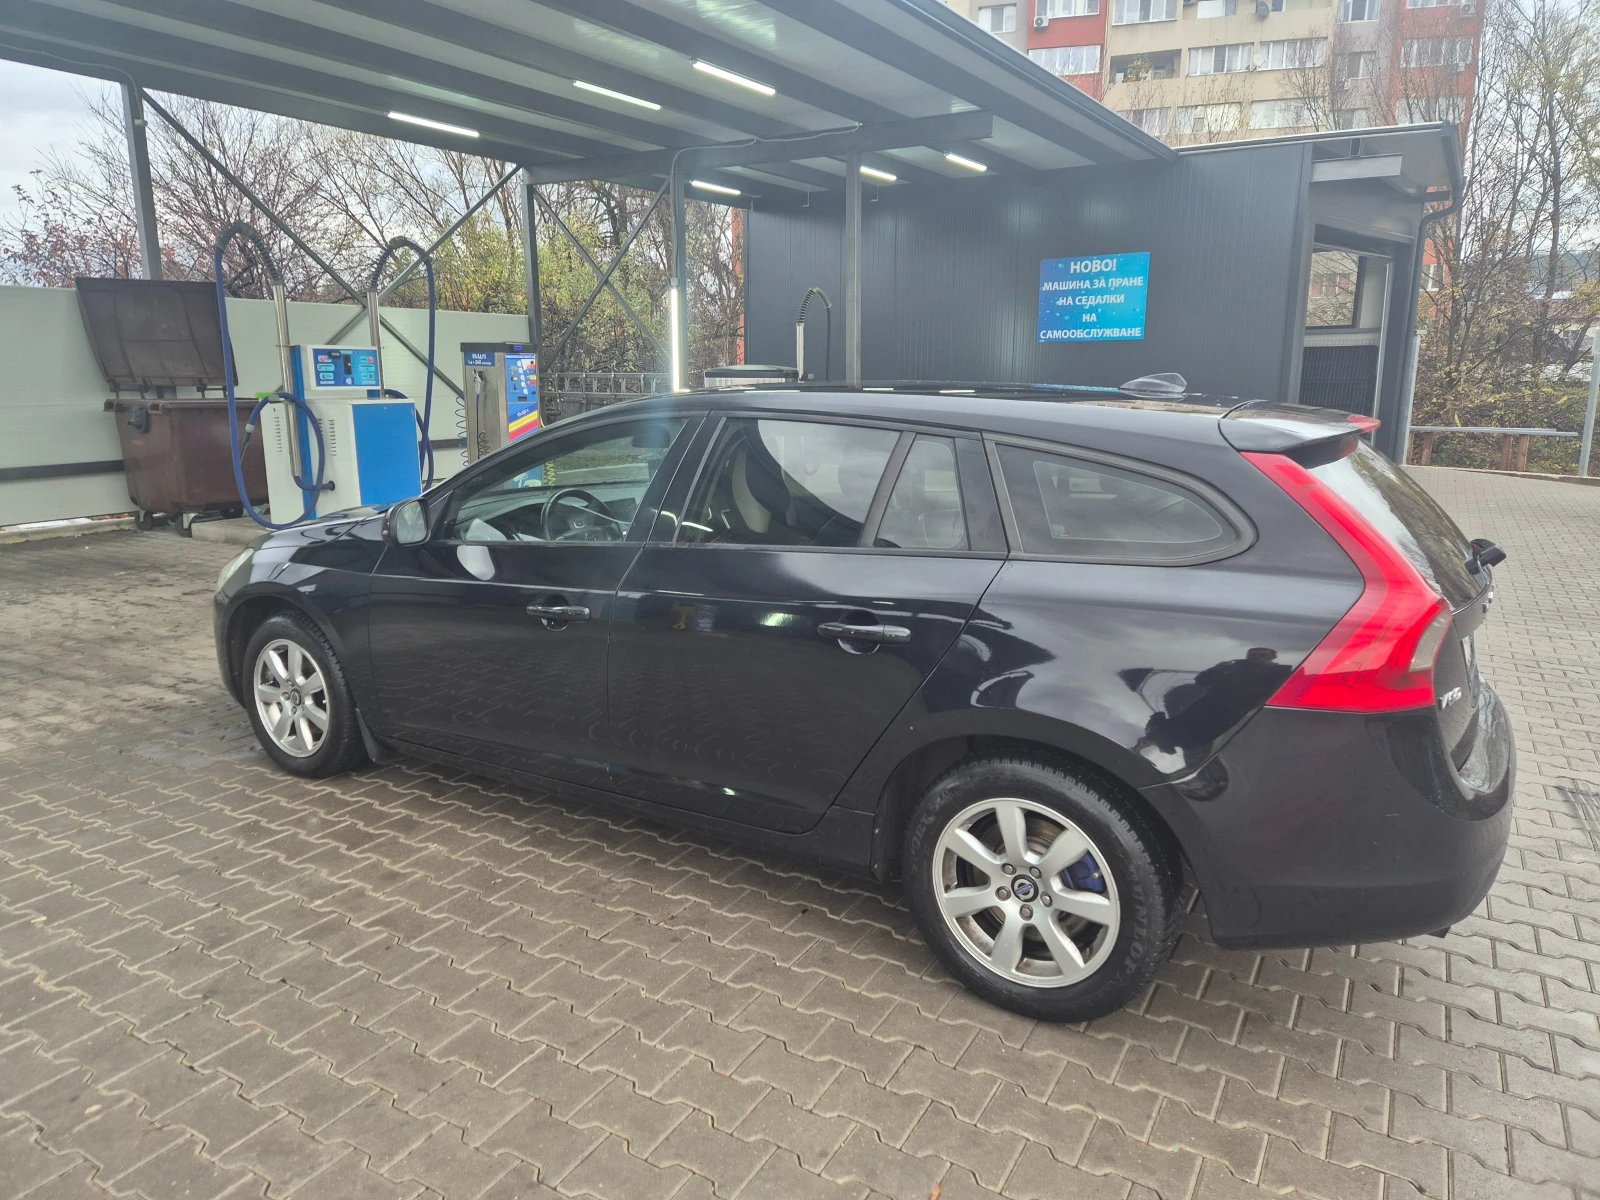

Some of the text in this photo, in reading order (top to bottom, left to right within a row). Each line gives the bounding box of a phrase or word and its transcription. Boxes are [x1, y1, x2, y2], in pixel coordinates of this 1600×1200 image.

[1070, 258, 1117, 274] НОВО!
[1043, 277, 1144, 291] МАШИНА ЗА ПРАНЕ
[1059, 294, 1125, 306] НА СЕДАЛКИ
[1082, 313, 1097, 322] НА
[1040, 327, 1142, 339] САМООБСЛУЖВАНЕ
